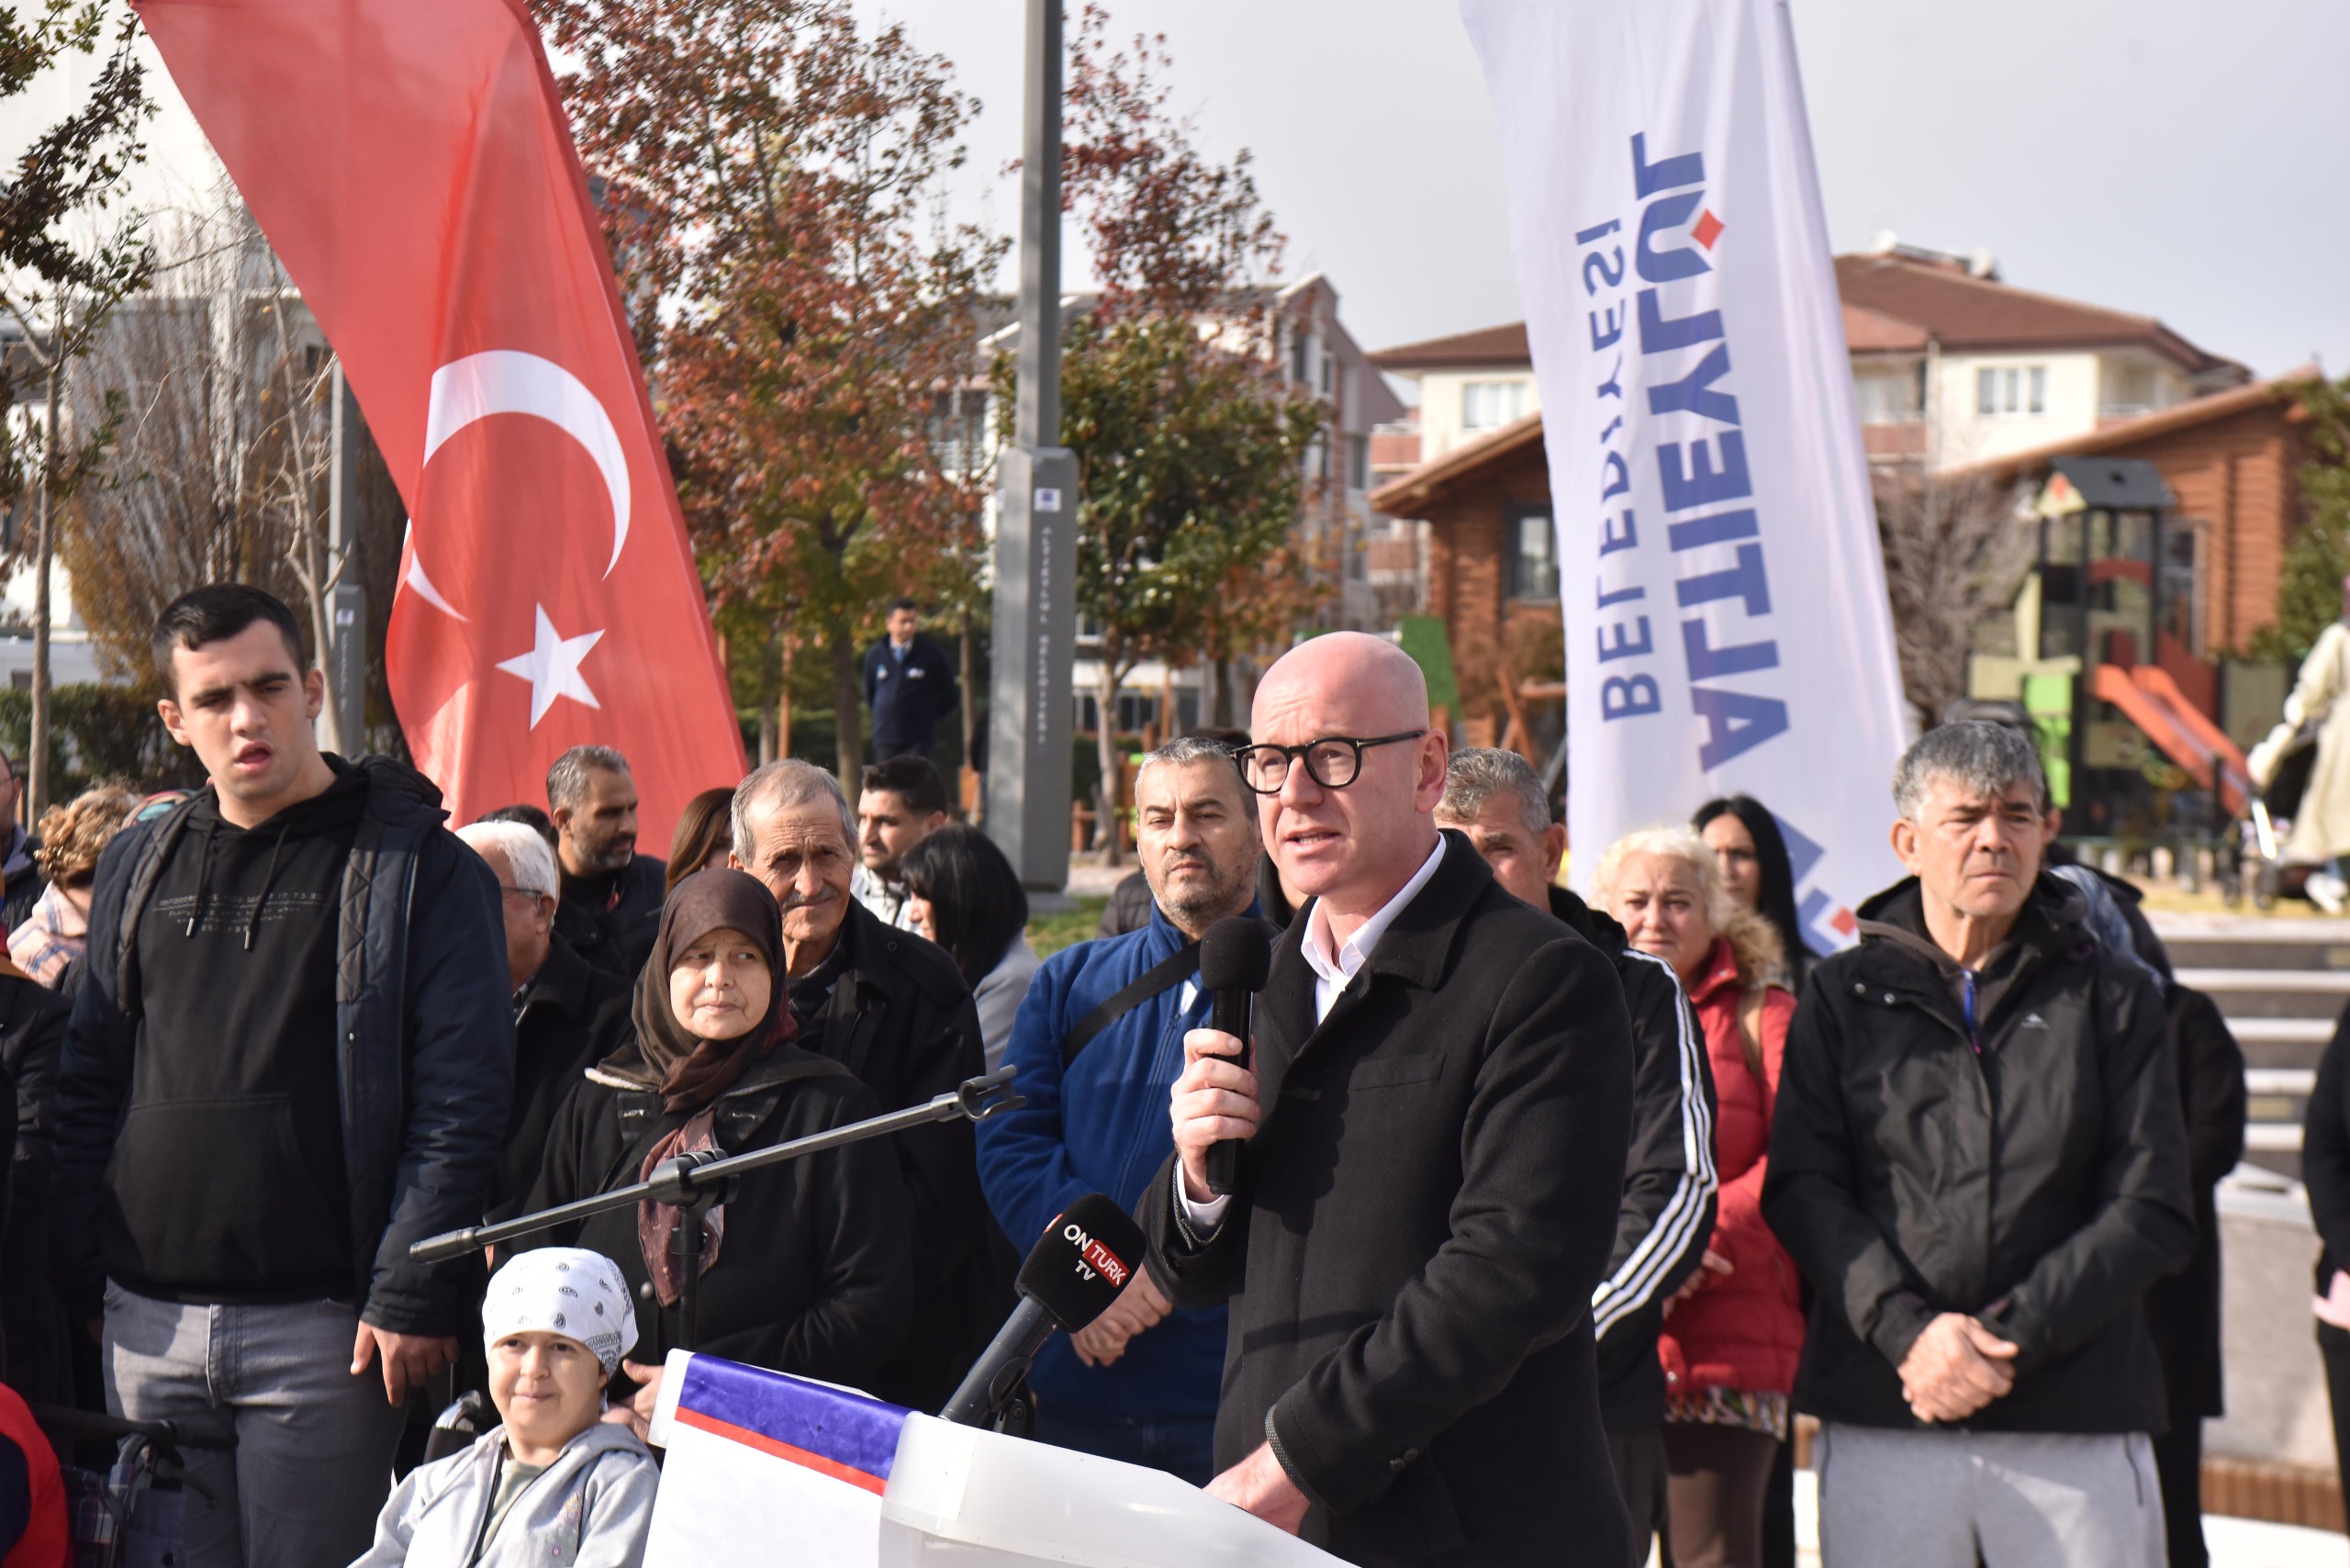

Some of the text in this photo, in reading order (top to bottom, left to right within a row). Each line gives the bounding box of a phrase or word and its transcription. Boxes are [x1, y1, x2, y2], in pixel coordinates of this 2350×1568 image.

[1064, 1224, 1125, 1285] ON TURK
[1075, 1260, 1096, 1281] TV
